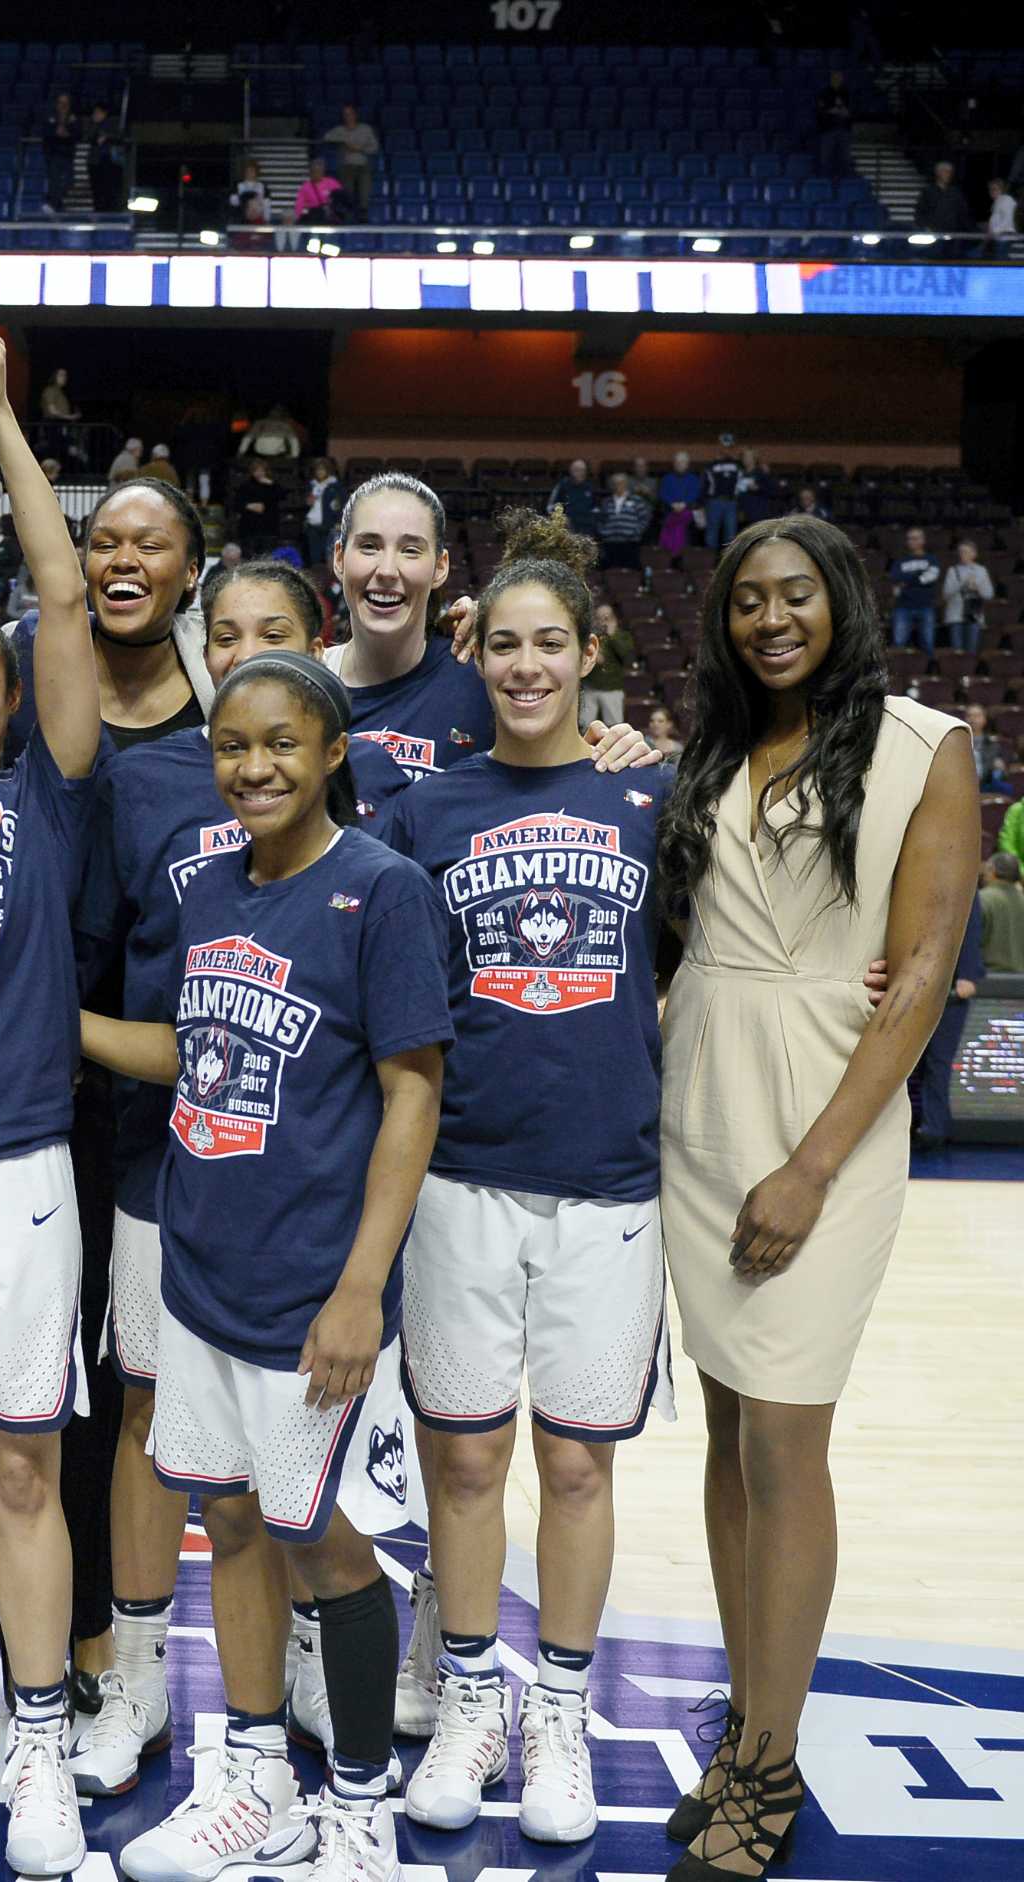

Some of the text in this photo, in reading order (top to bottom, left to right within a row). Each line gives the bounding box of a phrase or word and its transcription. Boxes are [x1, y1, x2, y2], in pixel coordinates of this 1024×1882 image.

[490, 0, 561, 30] 107
[572, 371, 627, 407] 16
[481, 826, 609, 851] AMERICAN
[449, 852, 639, 903] CHAMPIONS
[476, 909, 618, 927] 2014 2016
[478, 930, 616, 946] 2015 2017
[189, 950, 280, 982] AMERICAN
[476, 952, 619, 966] UCONN HUSKIES
[495, 971, 528, 980] WOMEN'S
[558, 973, 608, 982] BASKETBALL
[178, 979, 306, 1046] HAMPIONS
[243, 1052, 271, 1071] 2016
[240, 1074, 268, 1093] 2017
[228, 1098, 271, 1116] HUSKIES
[211, 1116, 257, 1132] BASKETBALL
